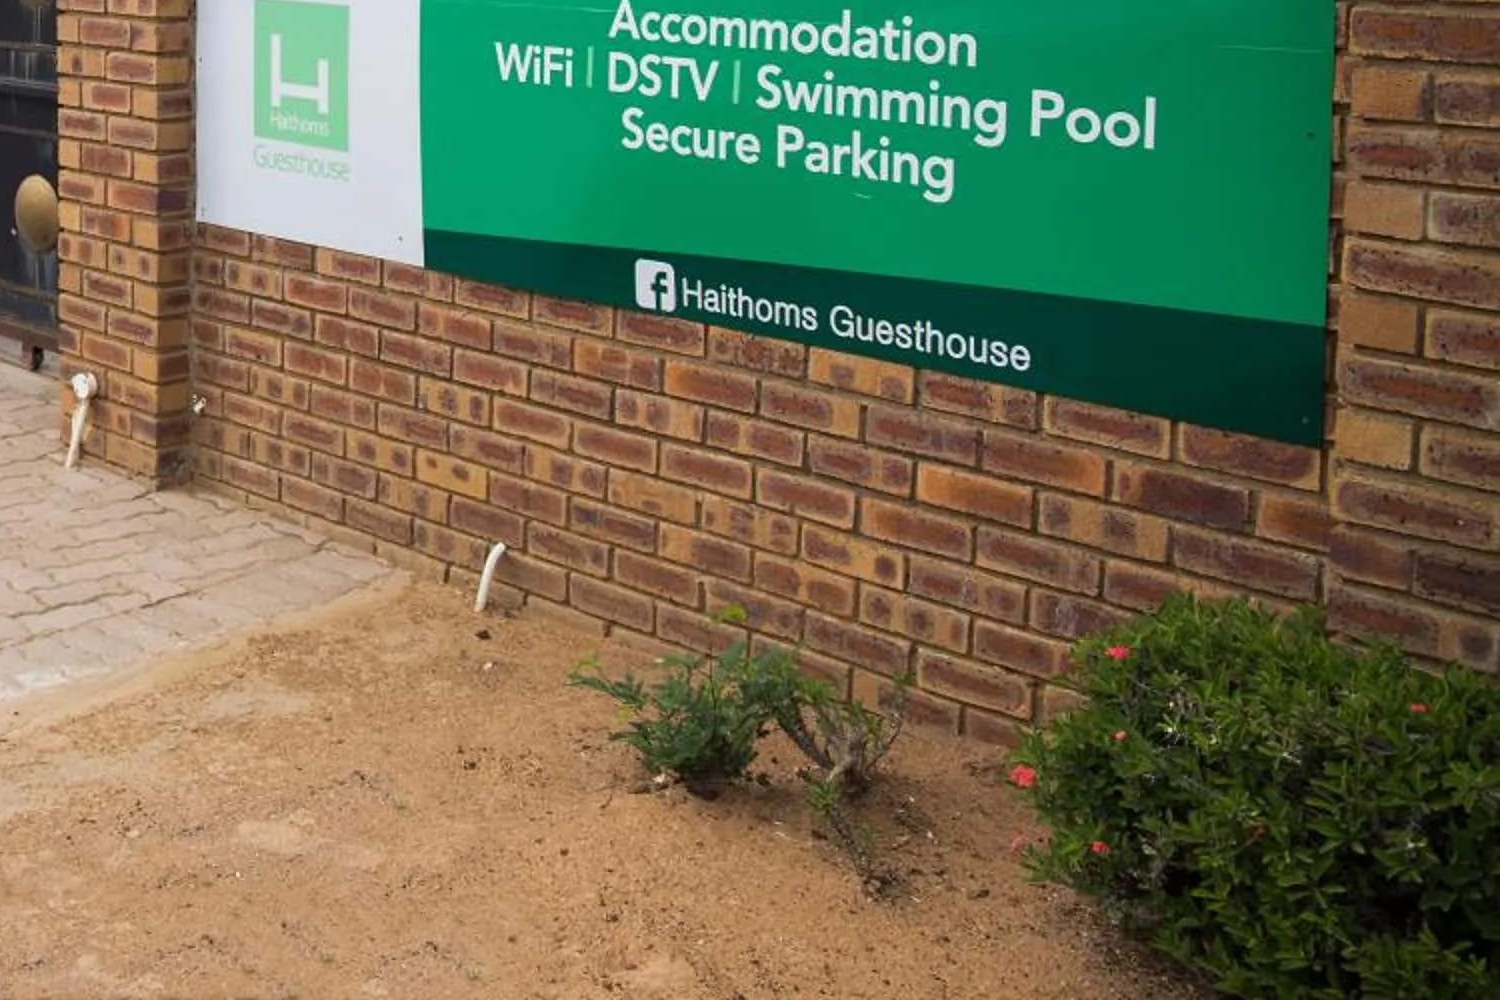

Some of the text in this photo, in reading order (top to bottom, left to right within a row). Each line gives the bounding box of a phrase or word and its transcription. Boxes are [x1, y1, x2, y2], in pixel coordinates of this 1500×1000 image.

[495, 42, 574, 88] WiFi
[607, 51, 720, 101] DSTV
[755, 64, 1007, 148] Swimming
[1029, 89, 1158, 150] Pool
[253, 143, 351, 182] Guesthouse
[620, 107, 955, 203] Secure Parking
[681, 276, 819, 332] Haithoms
[829, 304, 1032, 371] Guesthouse
